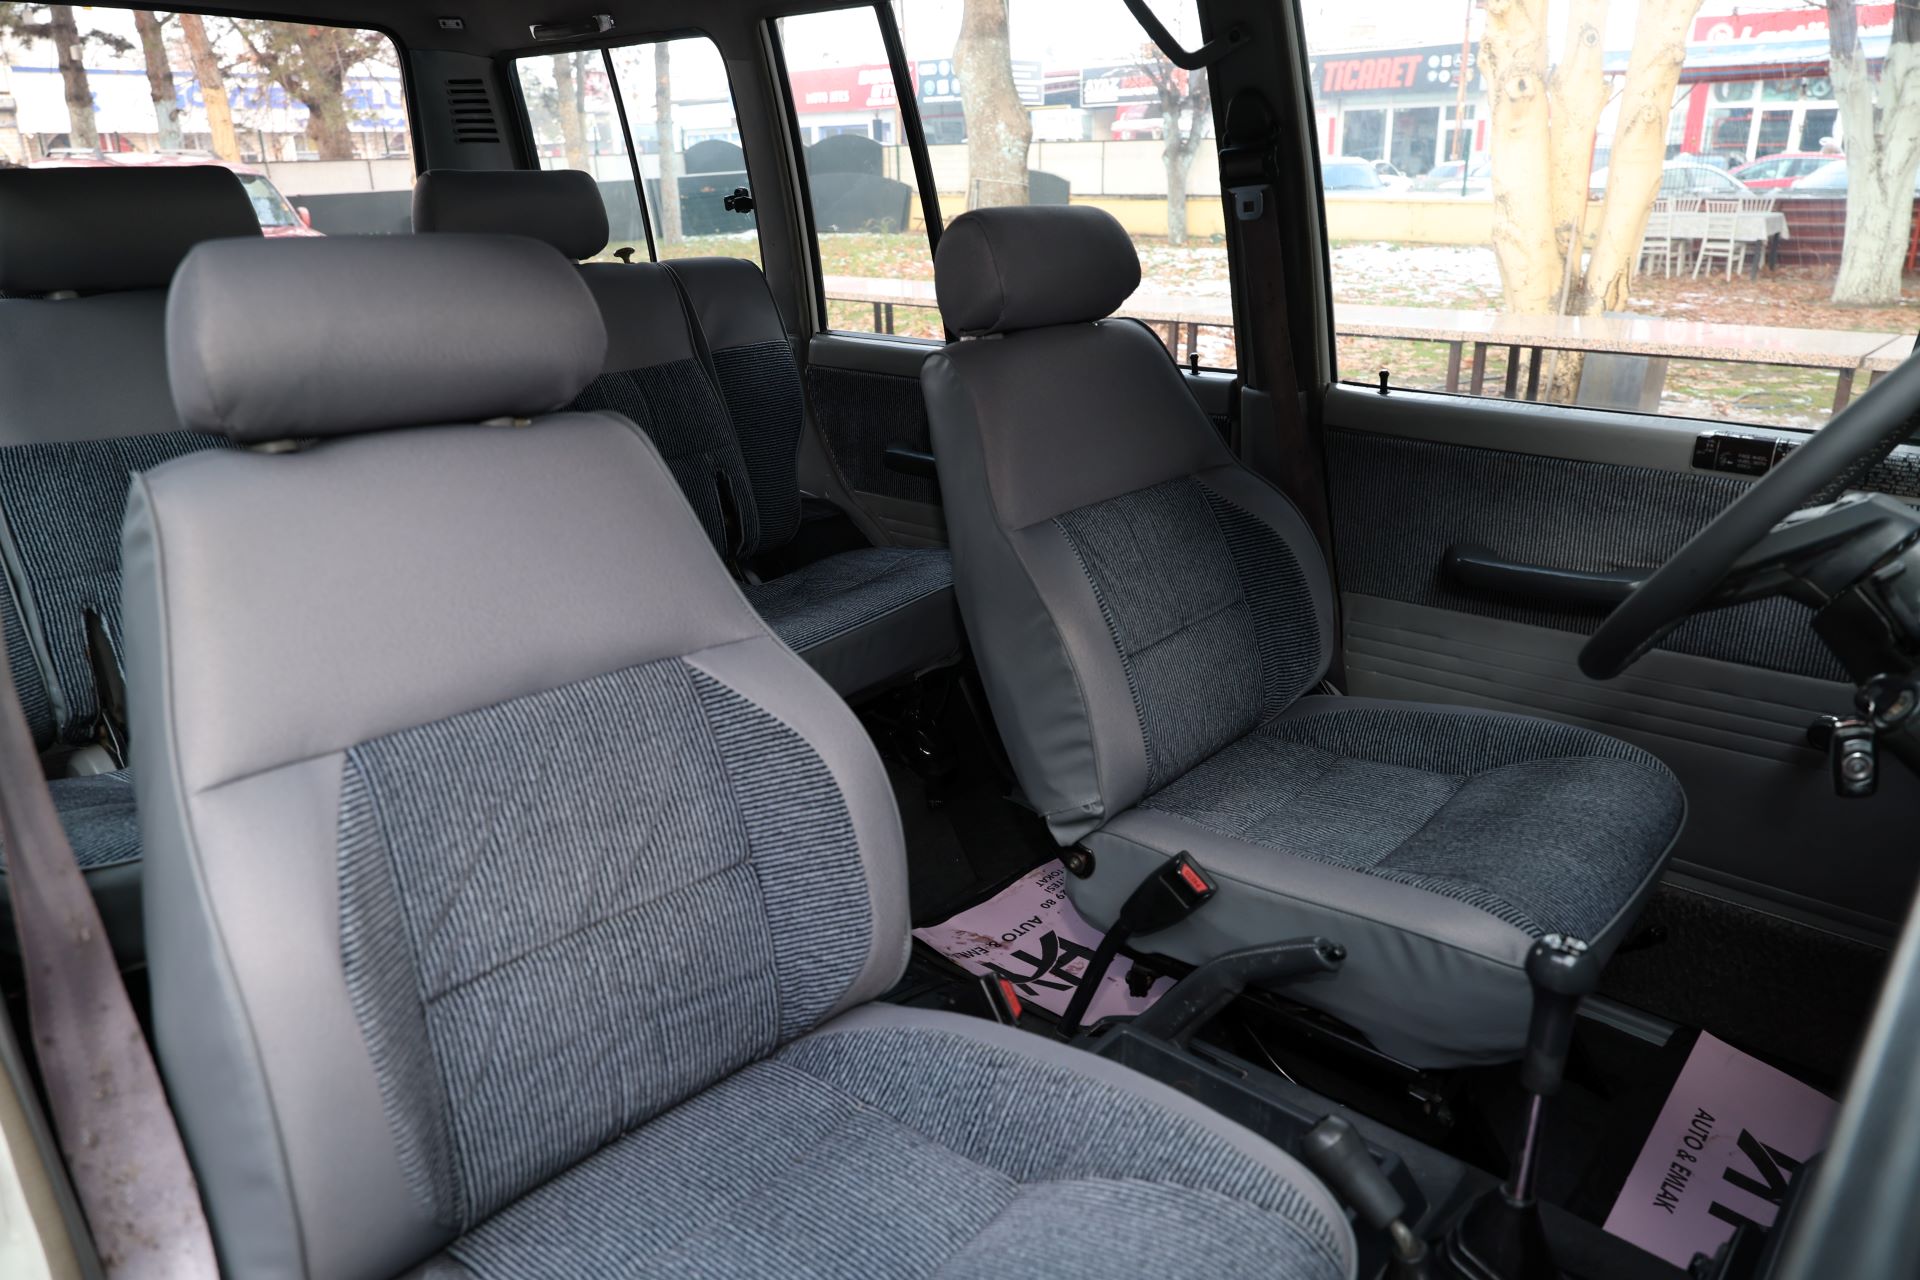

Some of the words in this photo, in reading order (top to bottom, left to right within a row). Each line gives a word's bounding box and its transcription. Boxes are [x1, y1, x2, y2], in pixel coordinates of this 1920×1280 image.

[1040, 899, 1057, 909] 80
[1001, 915, 1043, 942] AUTO
[1683, 1107, 1716, 1151] AUTO
[1676, 1149, 1698, 1163] &
[1653, 1161, 1692, 1214] EMLAK
